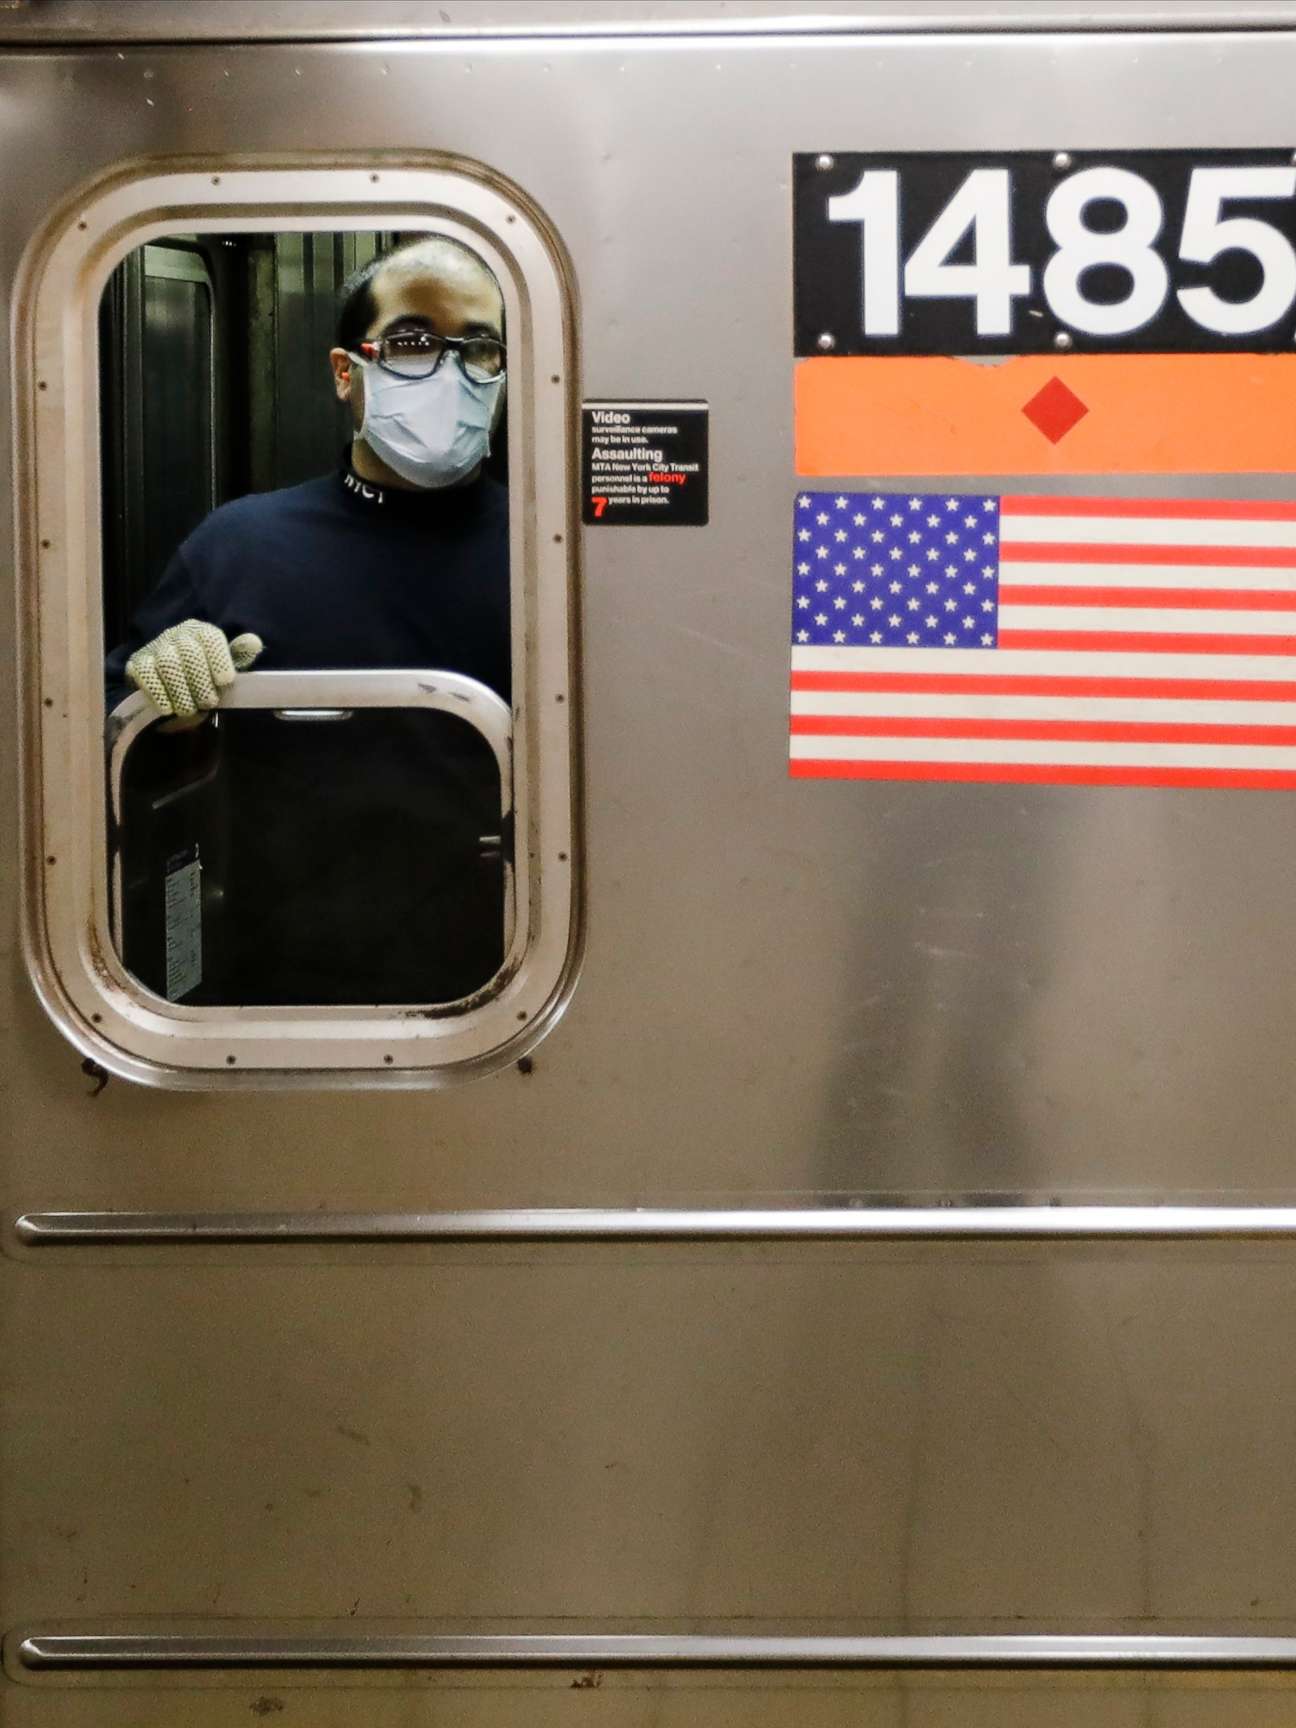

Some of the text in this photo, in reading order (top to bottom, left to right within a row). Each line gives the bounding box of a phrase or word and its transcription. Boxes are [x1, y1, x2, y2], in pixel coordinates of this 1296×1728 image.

[592, 411, 631, 424] Video
[592, 425, 678, 434] surveillance cameras
[592, 436, 609, 445] may
[610, 435, 621, 443] be
[622, 435, 631, 443] in
[592, 447, 663, 463] Assaulting
[592, 463, 699, 473] MTA New York City Transit
[592, 475, 632, 484] personnel
[633, 475, 641, 483] is
[649, 471, 686, 485] felony
[592, 485, 636, 495] punishable
[637, 485, 648, 495] by
[648, 486, 660, 494] up
[592, 496, 669, 518] 7 years in prison.
